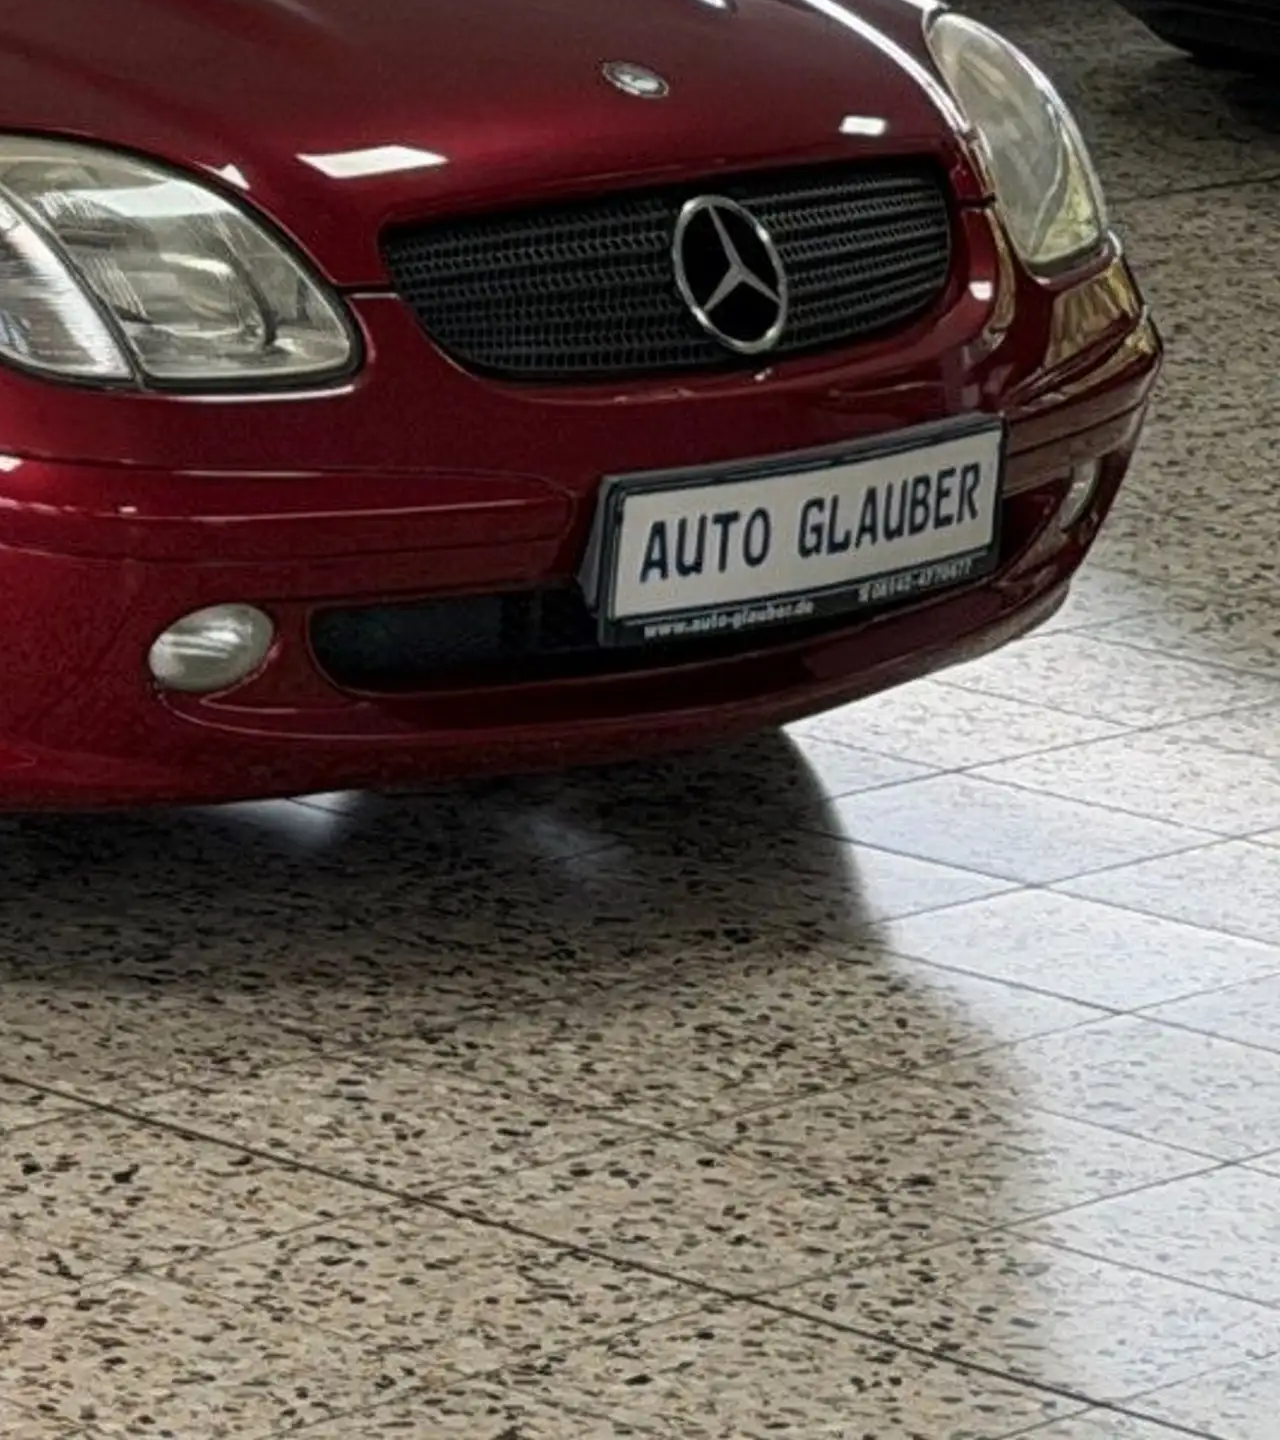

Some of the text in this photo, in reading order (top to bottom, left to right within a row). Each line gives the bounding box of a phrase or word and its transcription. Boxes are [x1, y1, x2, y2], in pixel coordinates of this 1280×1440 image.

[639, 461, 982, 584] AUTO GLAUBER
[643, 598, 815, 640] www.auto-glauber.de
